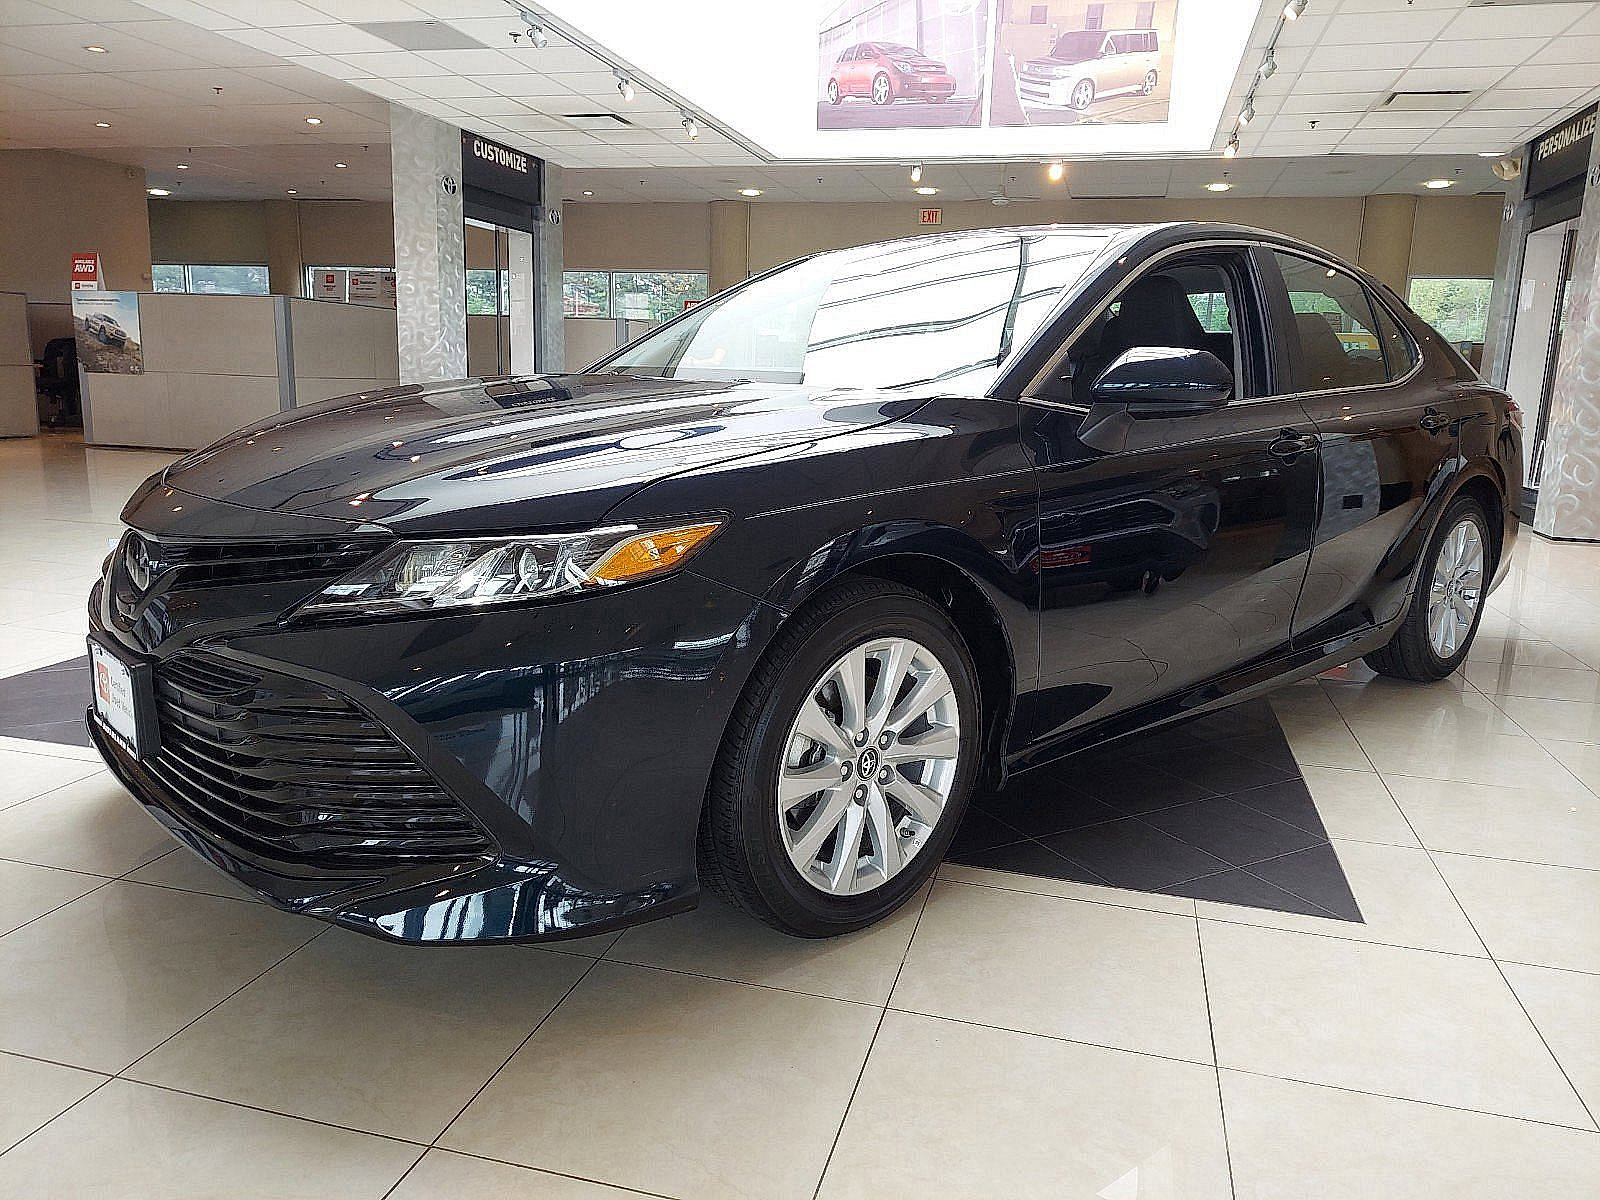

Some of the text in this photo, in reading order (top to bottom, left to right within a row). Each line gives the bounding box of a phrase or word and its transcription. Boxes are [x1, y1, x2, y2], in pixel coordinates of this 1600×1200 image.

[1538, 114, 1596, 161] PERSONALIZE
[473, 140, 527, 173] CUSTOMIZE
[922, 210, 939, 223] EXIT
[74, 264, 95, 273] AWD
